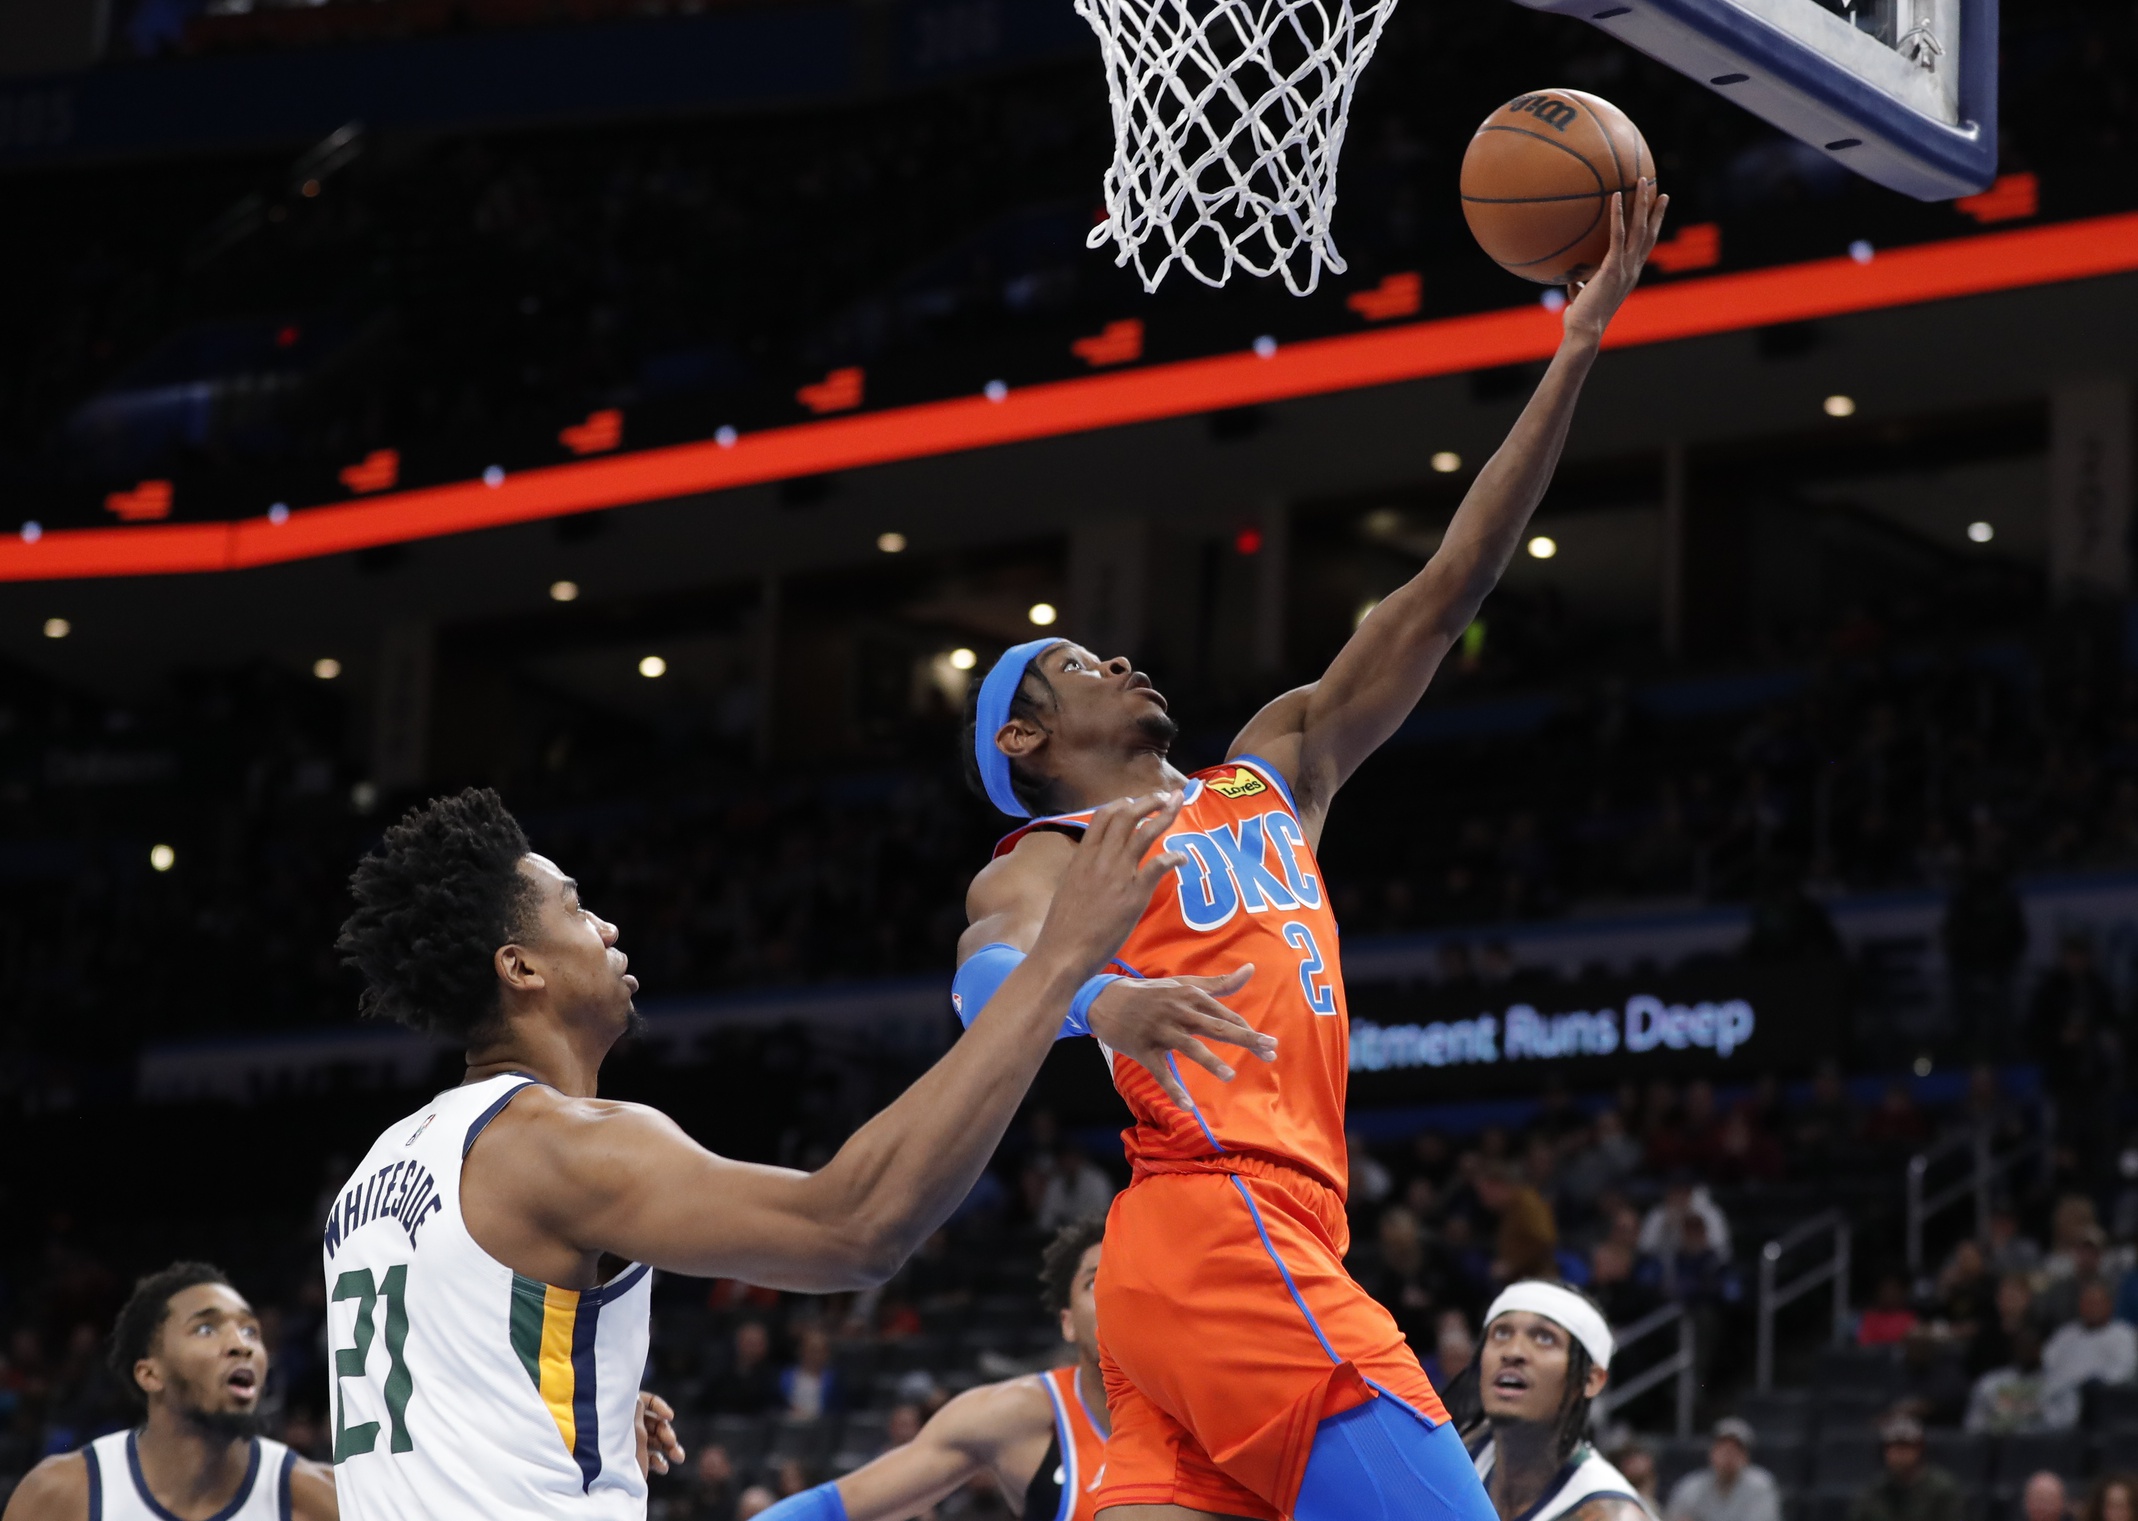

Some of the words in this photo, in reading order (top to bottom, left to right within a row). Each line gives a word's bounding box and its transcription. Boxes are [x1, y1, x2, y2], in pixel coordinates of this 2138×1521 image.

[1163, 810, 1322, 931] OKC
[1282, 920, 1337, 1016] 2
[1348, 1013, 1499, 1072] itment
[1504, 1003, 1620, 1060] Runs
[1624, 993, 1756, 1060] Deep
[325, 1160, 442, 1260] WHITESIDE
[331, 1264, 414, 1466] 21
